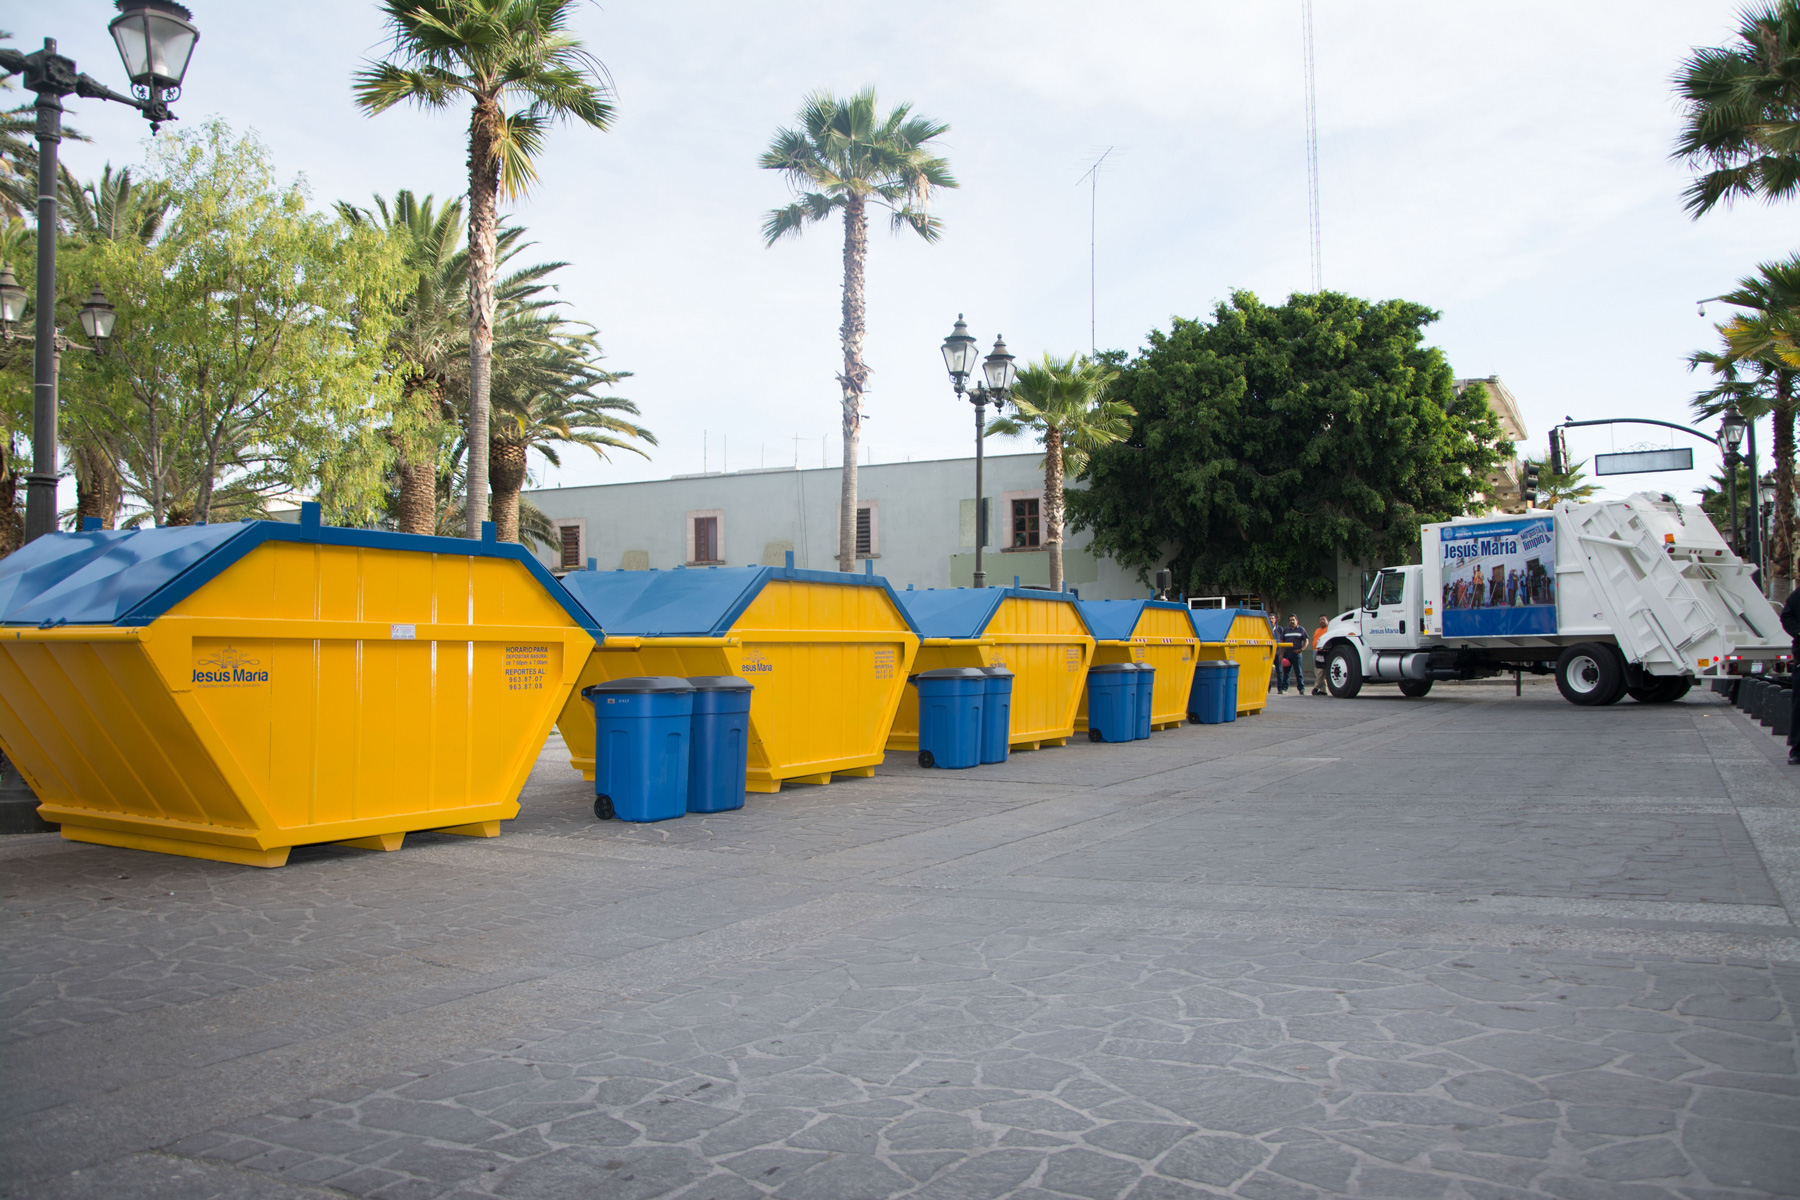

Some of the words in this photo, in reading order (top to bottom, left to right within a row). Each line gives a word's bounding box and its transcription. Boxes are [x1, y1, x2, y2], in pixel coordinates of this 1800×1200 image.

[1444, 541, 1478, 559] Jesús
[1480, 538, 1517, 556] María
[1522, 534, 1546, 551] limpio
[192, 668, 231, 682] Jesús
[232, 668, 268, 682] María
[505, 668, 537, 676] REPORTES
